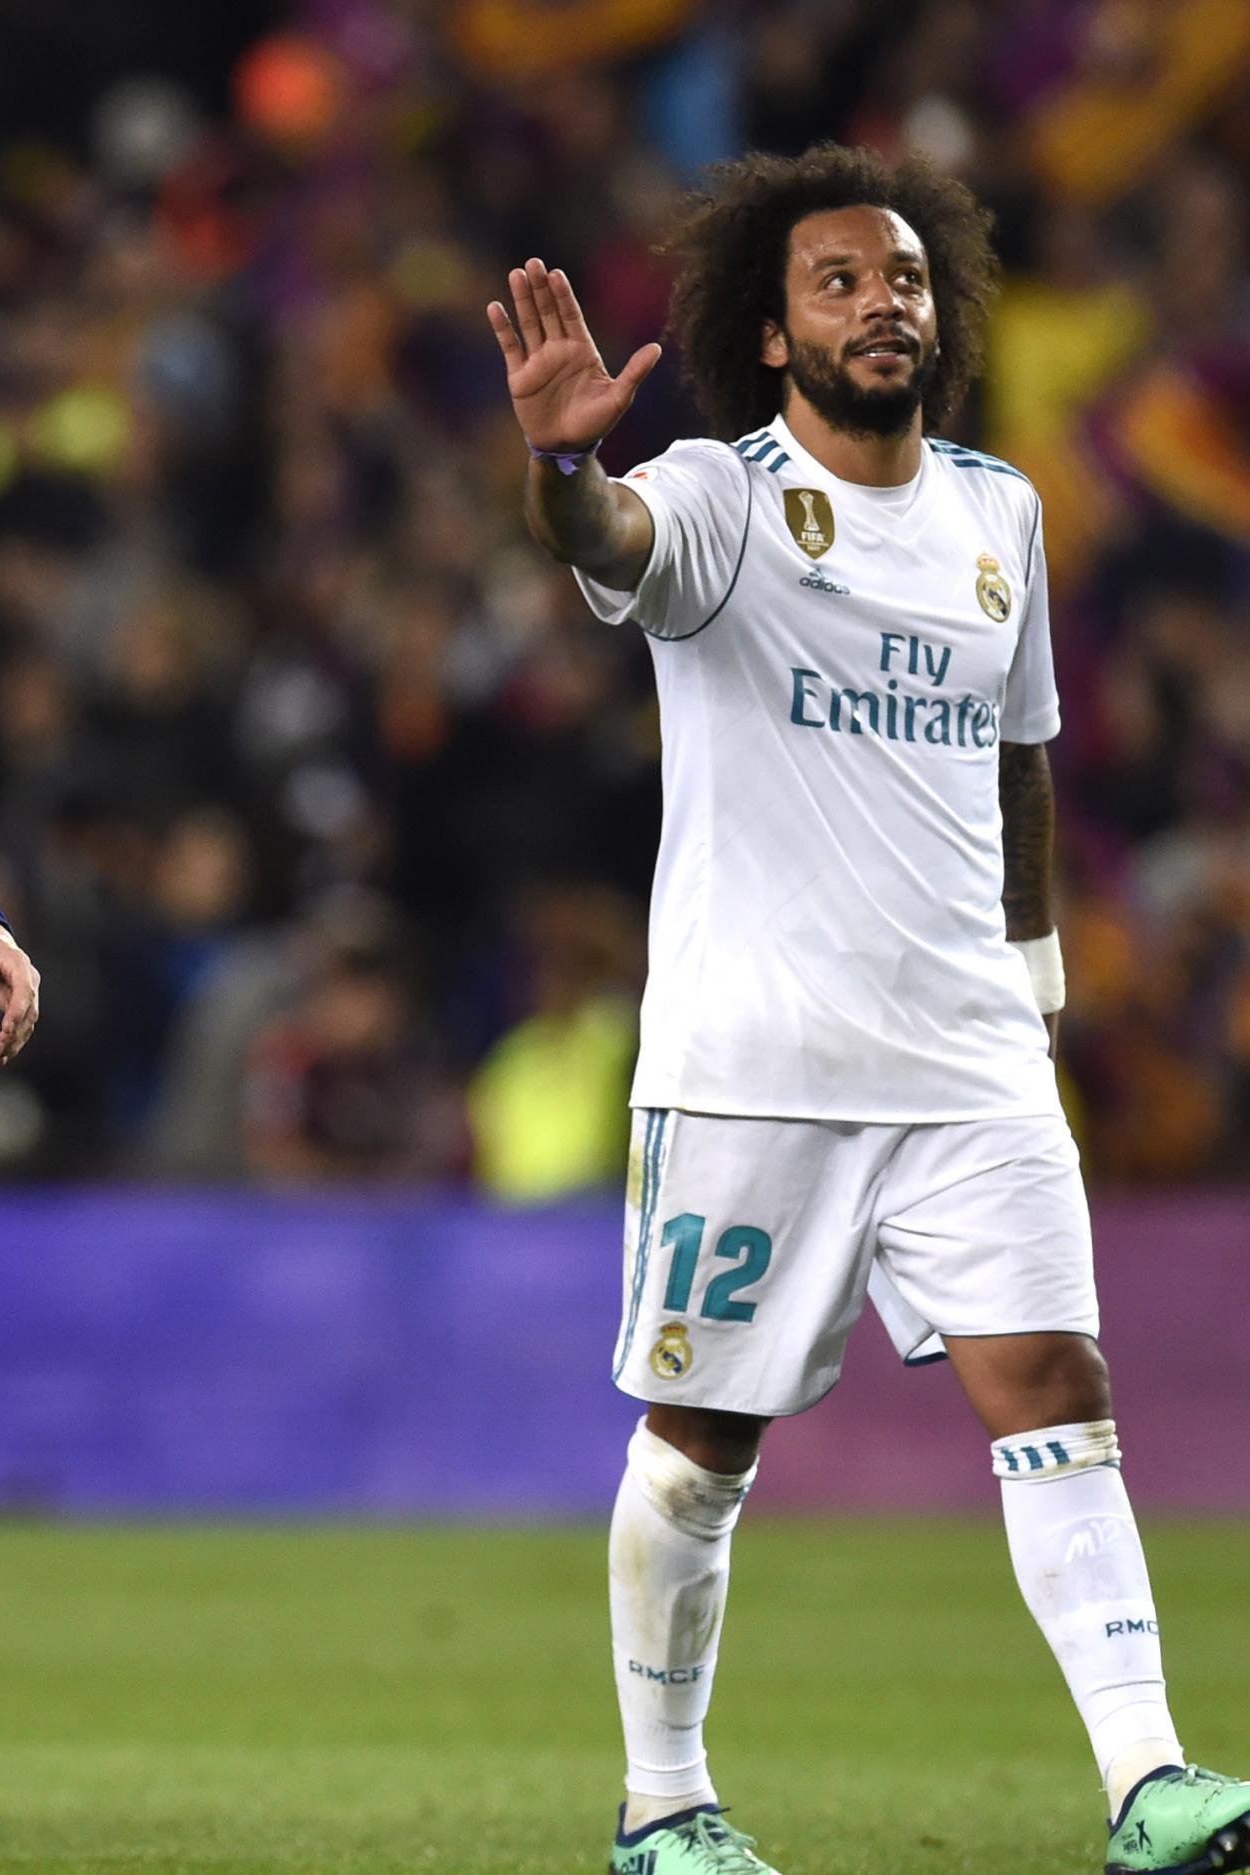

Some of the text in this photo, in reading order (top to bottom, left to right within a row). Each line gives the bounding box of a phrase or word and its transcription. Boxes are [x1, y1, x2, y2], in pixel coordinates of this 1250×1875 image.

[880, 632, 952, 687] Fly
[790, 666, 999, 748] Emirates
[660, 1212, 772, 1323] 12
[628, 1659, 705, 1685] RMCF
